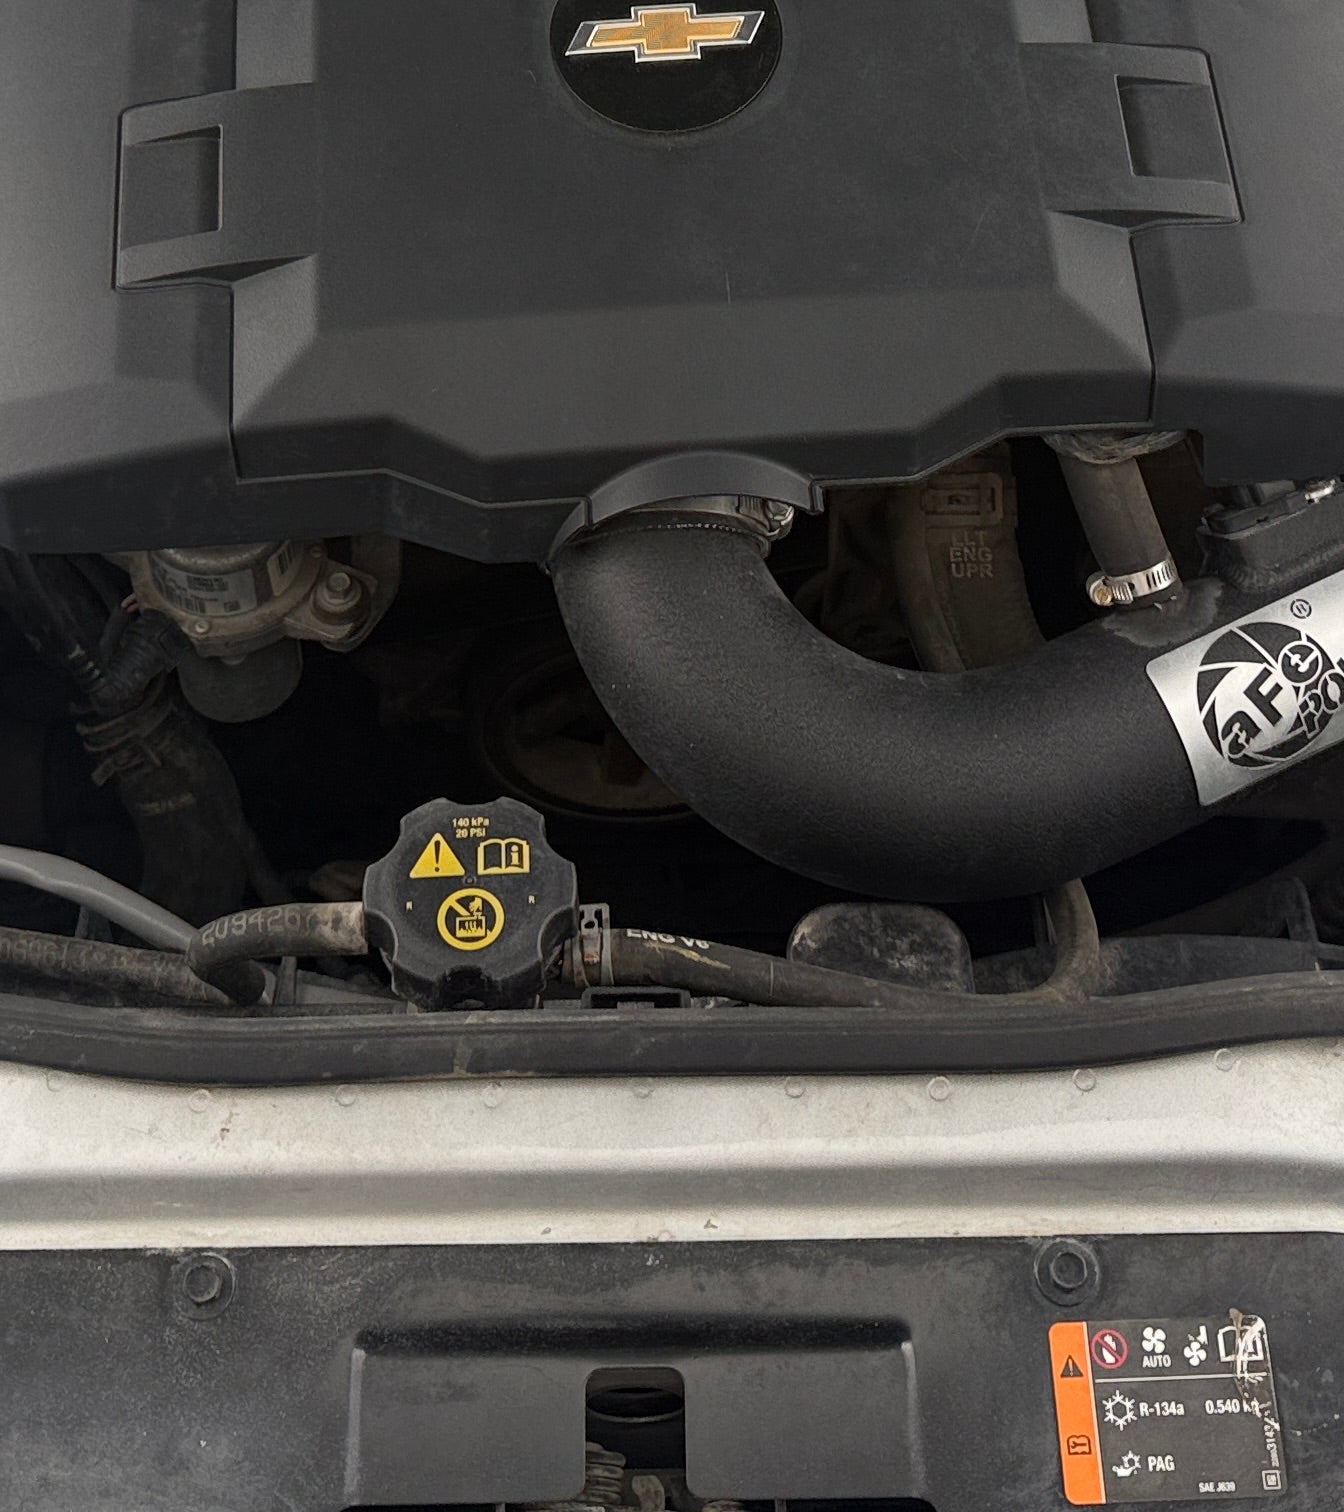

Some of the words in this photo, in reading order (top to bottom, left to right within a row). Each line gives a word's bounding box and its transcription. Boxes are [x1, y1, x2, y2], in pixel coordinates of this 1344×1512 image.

[950, 547, 993, 562] ENG
[951, 563, 993, 578] UPR
[452, 817, 469, 827] 140
[471, 816, 489, 826] kPa
[455, 828, 468, 838] 20
[469, 828, 486, 838] PSI
[1142, 1355, 1172, 1368] AUTO
[1139, 1401, 1184, 1417] R-134a
[1205, 1399, 1240, 1415] 0.540
[1147, 1455, 1175, 1472] PAG
